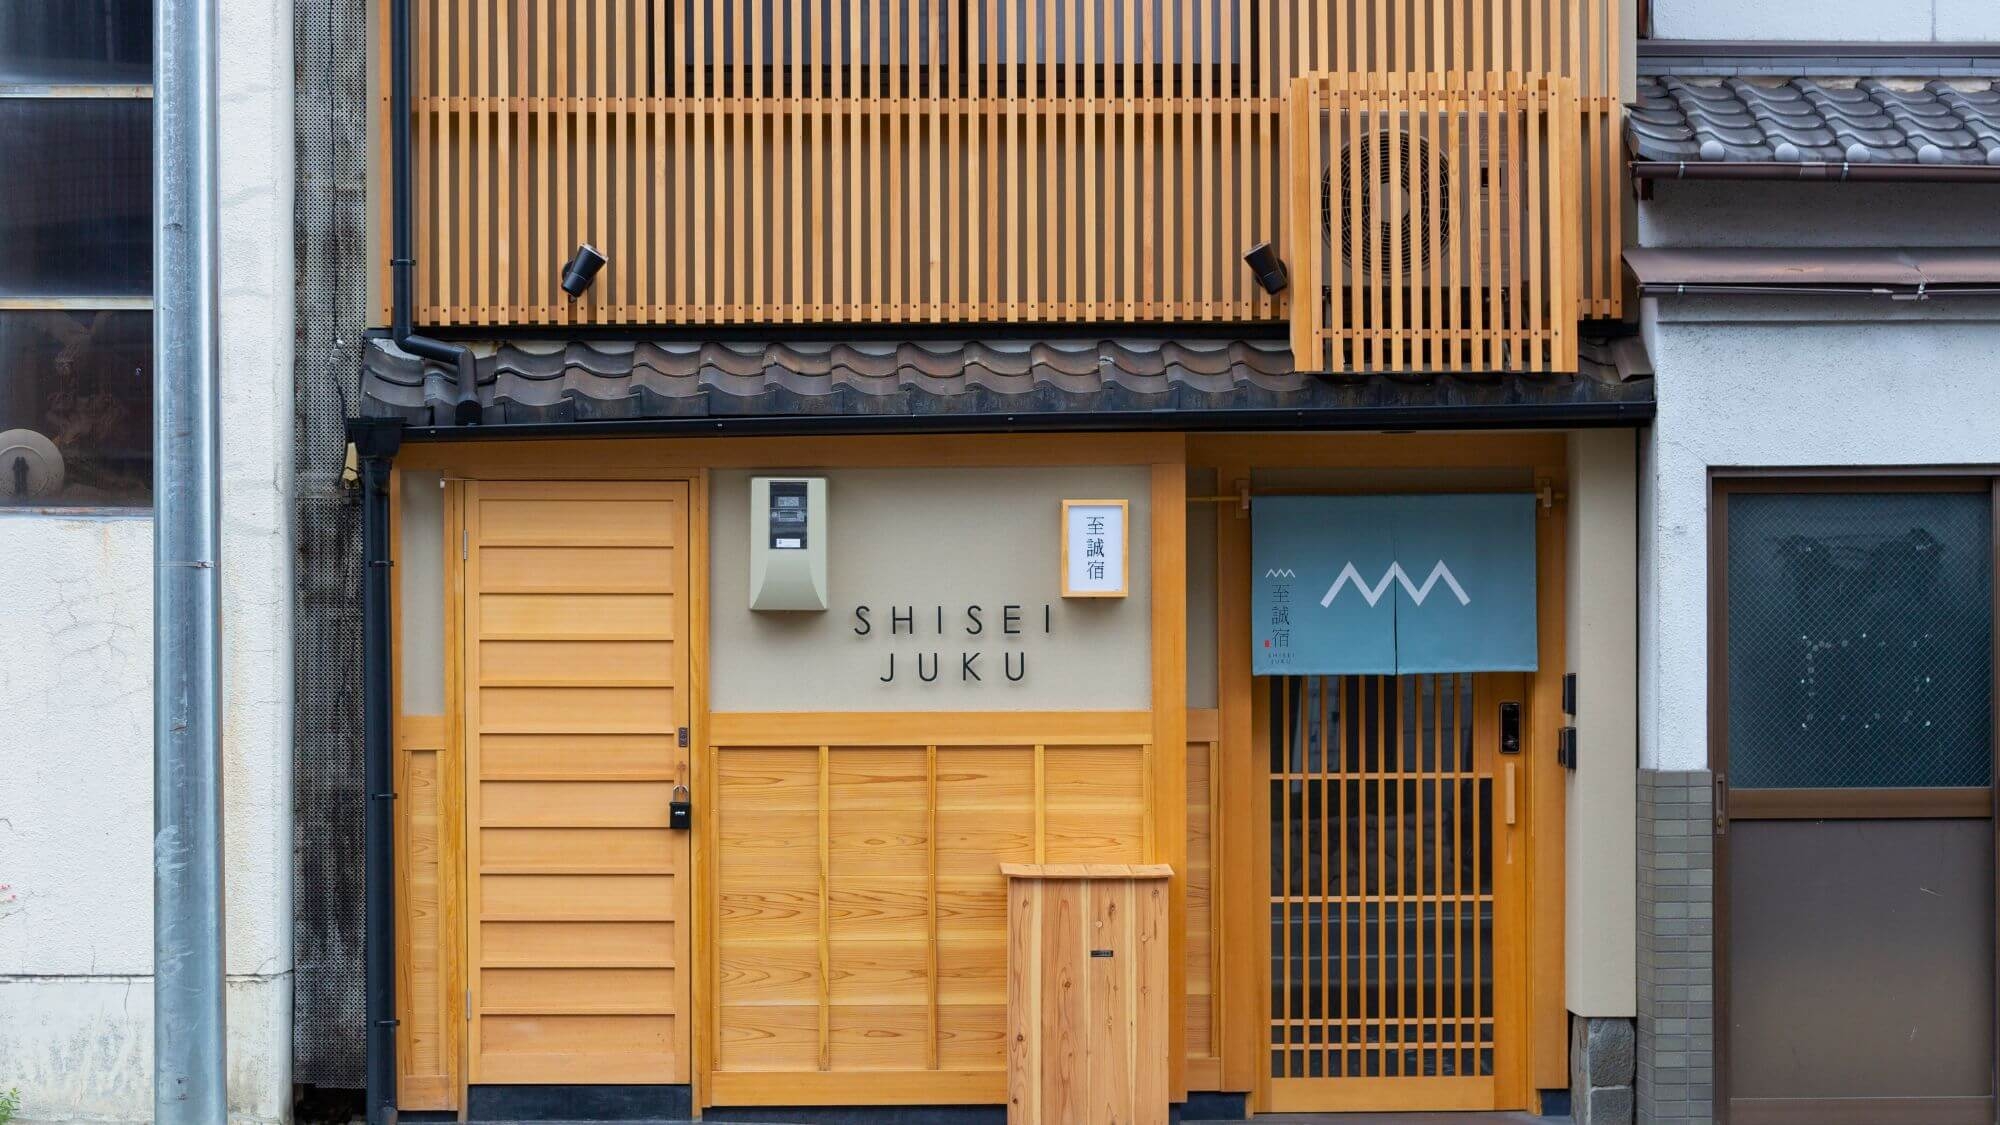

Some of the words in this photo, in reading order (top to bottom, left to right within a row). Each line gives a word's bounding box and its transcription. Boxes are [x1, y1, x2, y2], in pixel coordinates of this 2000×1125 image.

[1086, 516, 1105, 580] 至誠宿
[854, 604, 1051, 636] SHISEI
[1271, 584, 1290, 648] 至誠宿
[880, 652, 1025, 682] JUKU
